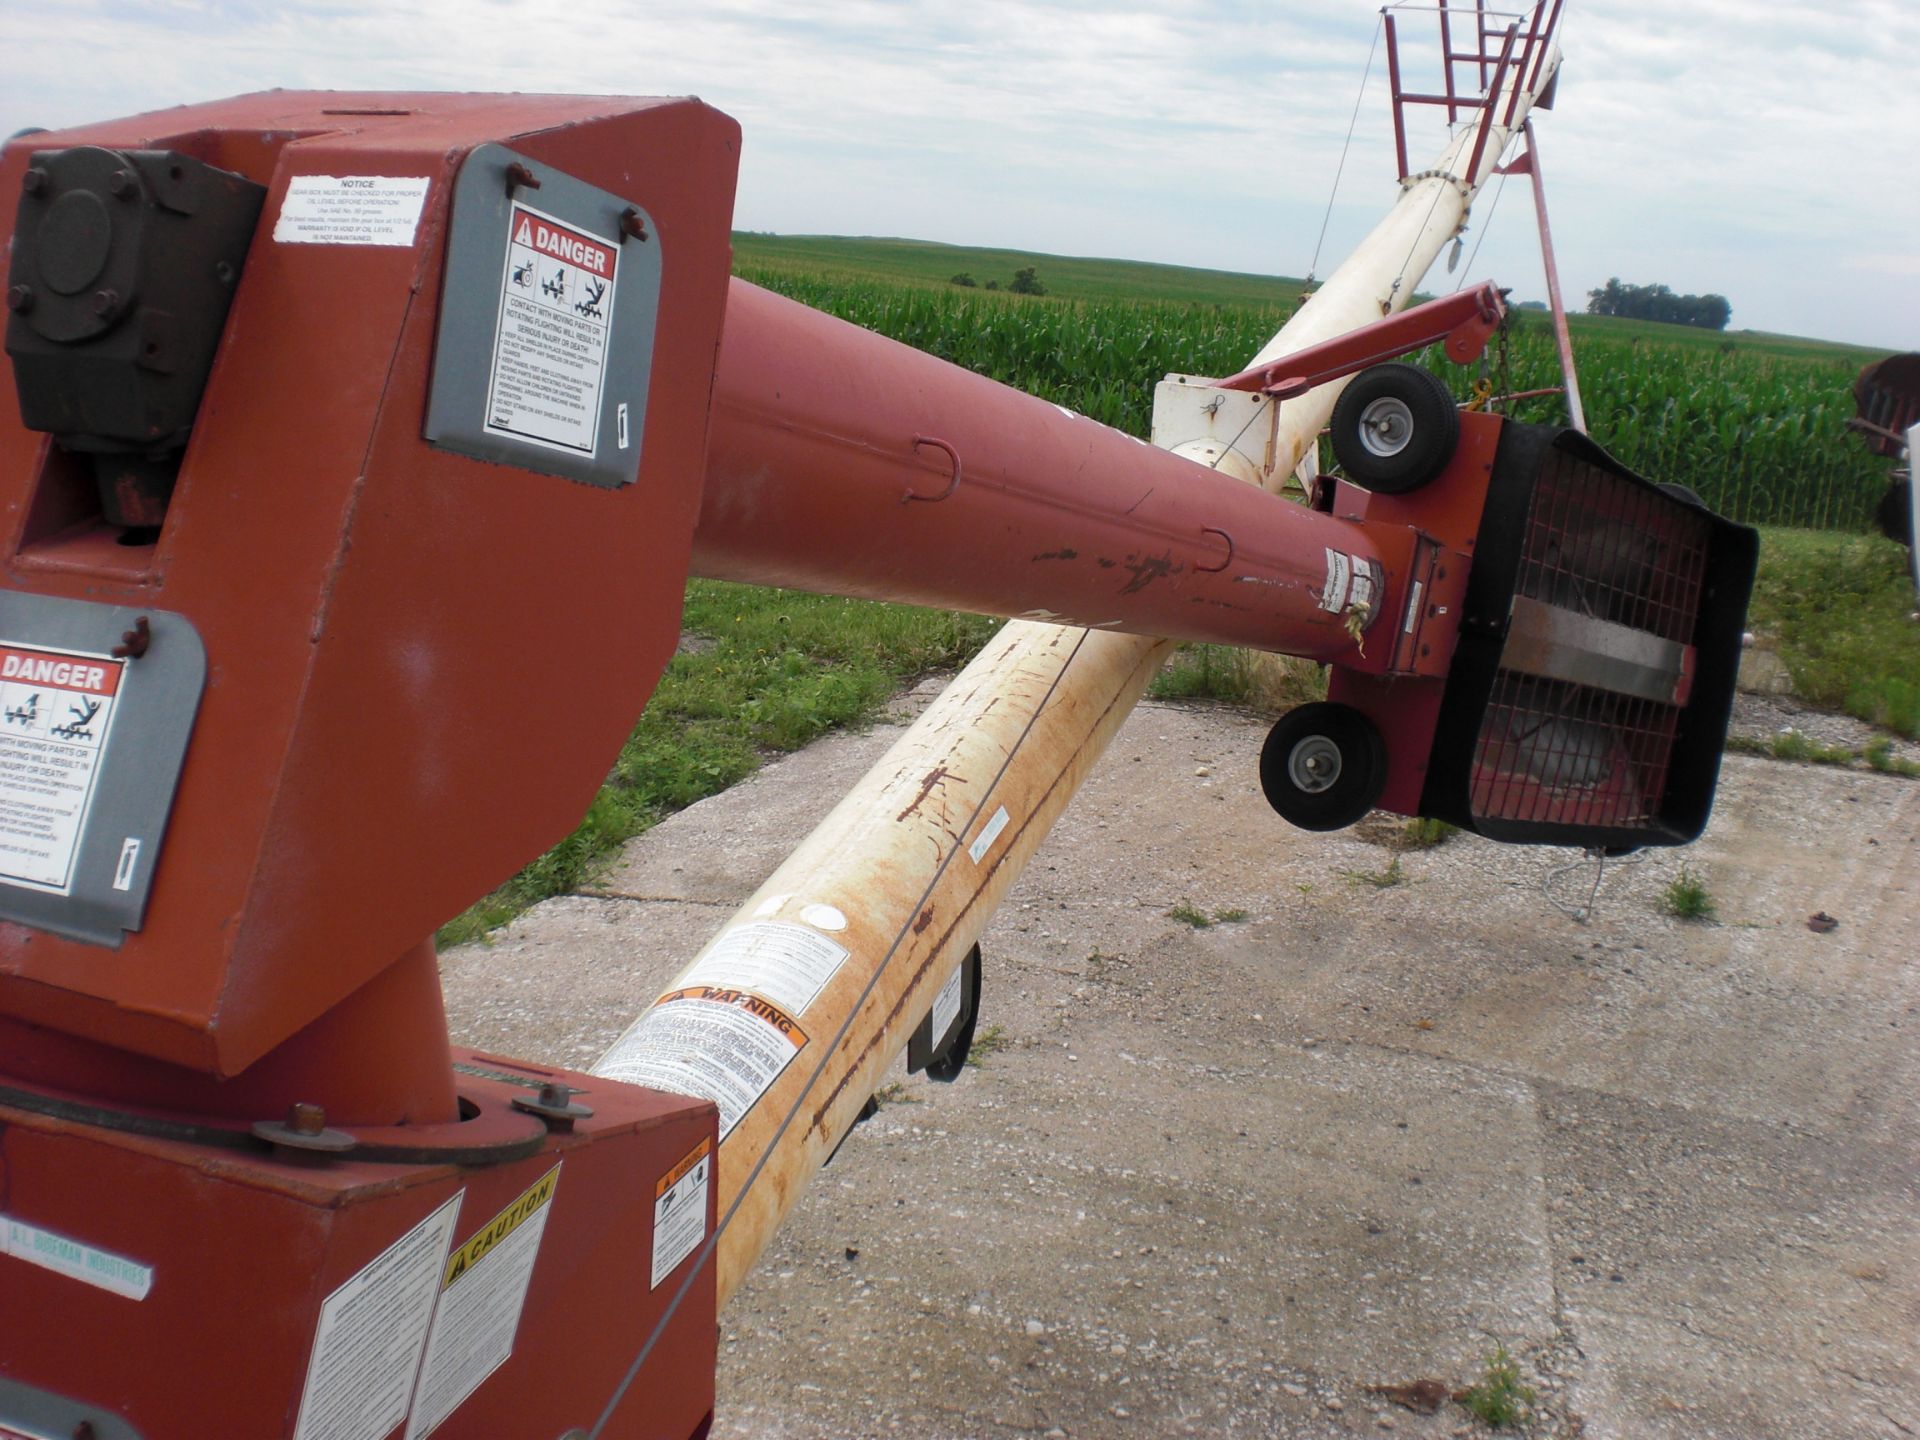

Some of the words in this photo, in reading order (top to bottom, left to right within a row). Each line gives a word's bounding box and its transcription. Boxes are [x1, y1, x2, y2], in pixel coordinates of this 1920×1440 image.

[340, 180, 375, 188] NOTICE
[536, 225, 606, 273] DANGER
[505, 308, 534, 325] ROTATING
[535, 318, 562, 334] FLIGHTING
[563, 327, 575, 338] WILL
[576, 332, 596, 345] RESULT
[596, 338, 602, 347] IN
[510, 298, 537, 314] CONTACT
[538, 307, 551, 319] WITH
[553, 313, 574, 326] MOVING
[575, 320, 591, 333] PARTS
[592, 326, 600, 336] OR
[518, 324, 541, 339] SERIOUS
[542, 332, 560, 345] INJURY
[561, 338, 569, 348] OR
[2, 655, 106, 691] DANGER
[16, 739, 48, 752] MOVING
[47, 744, 75, 757] PARTS
[75, 749, 88, 759] OR
[30, 753, 50, 764] WILL
[49, 757, 81, 770] RESULT
[80, 762, 89, 771] IN
[26, 765, 39, 774] OR
[470, 1181, 551, 1261] CAUTION
